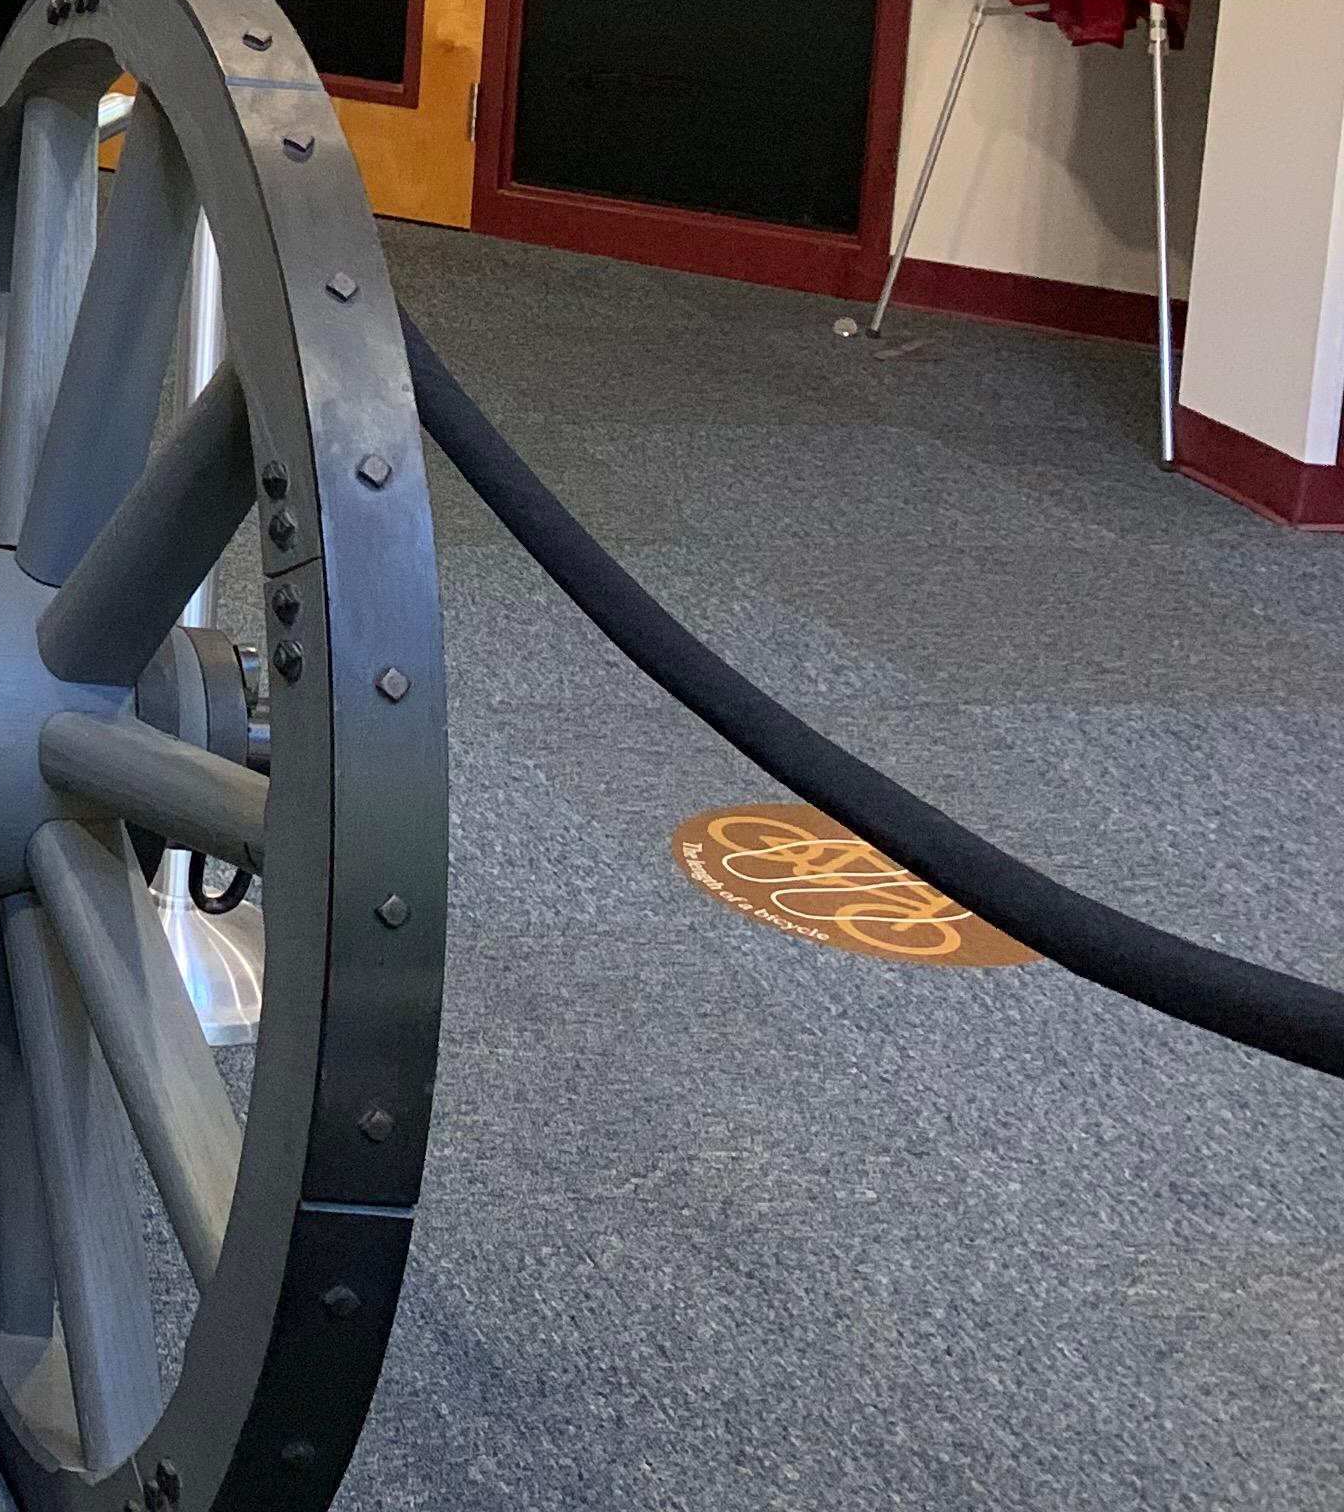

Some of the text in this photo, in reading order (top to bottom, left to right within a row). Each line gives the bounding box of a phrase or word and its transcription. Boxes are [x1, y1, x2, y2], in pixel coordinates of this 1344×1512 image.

[682, 841, 830, 941] The length of a bicycle
